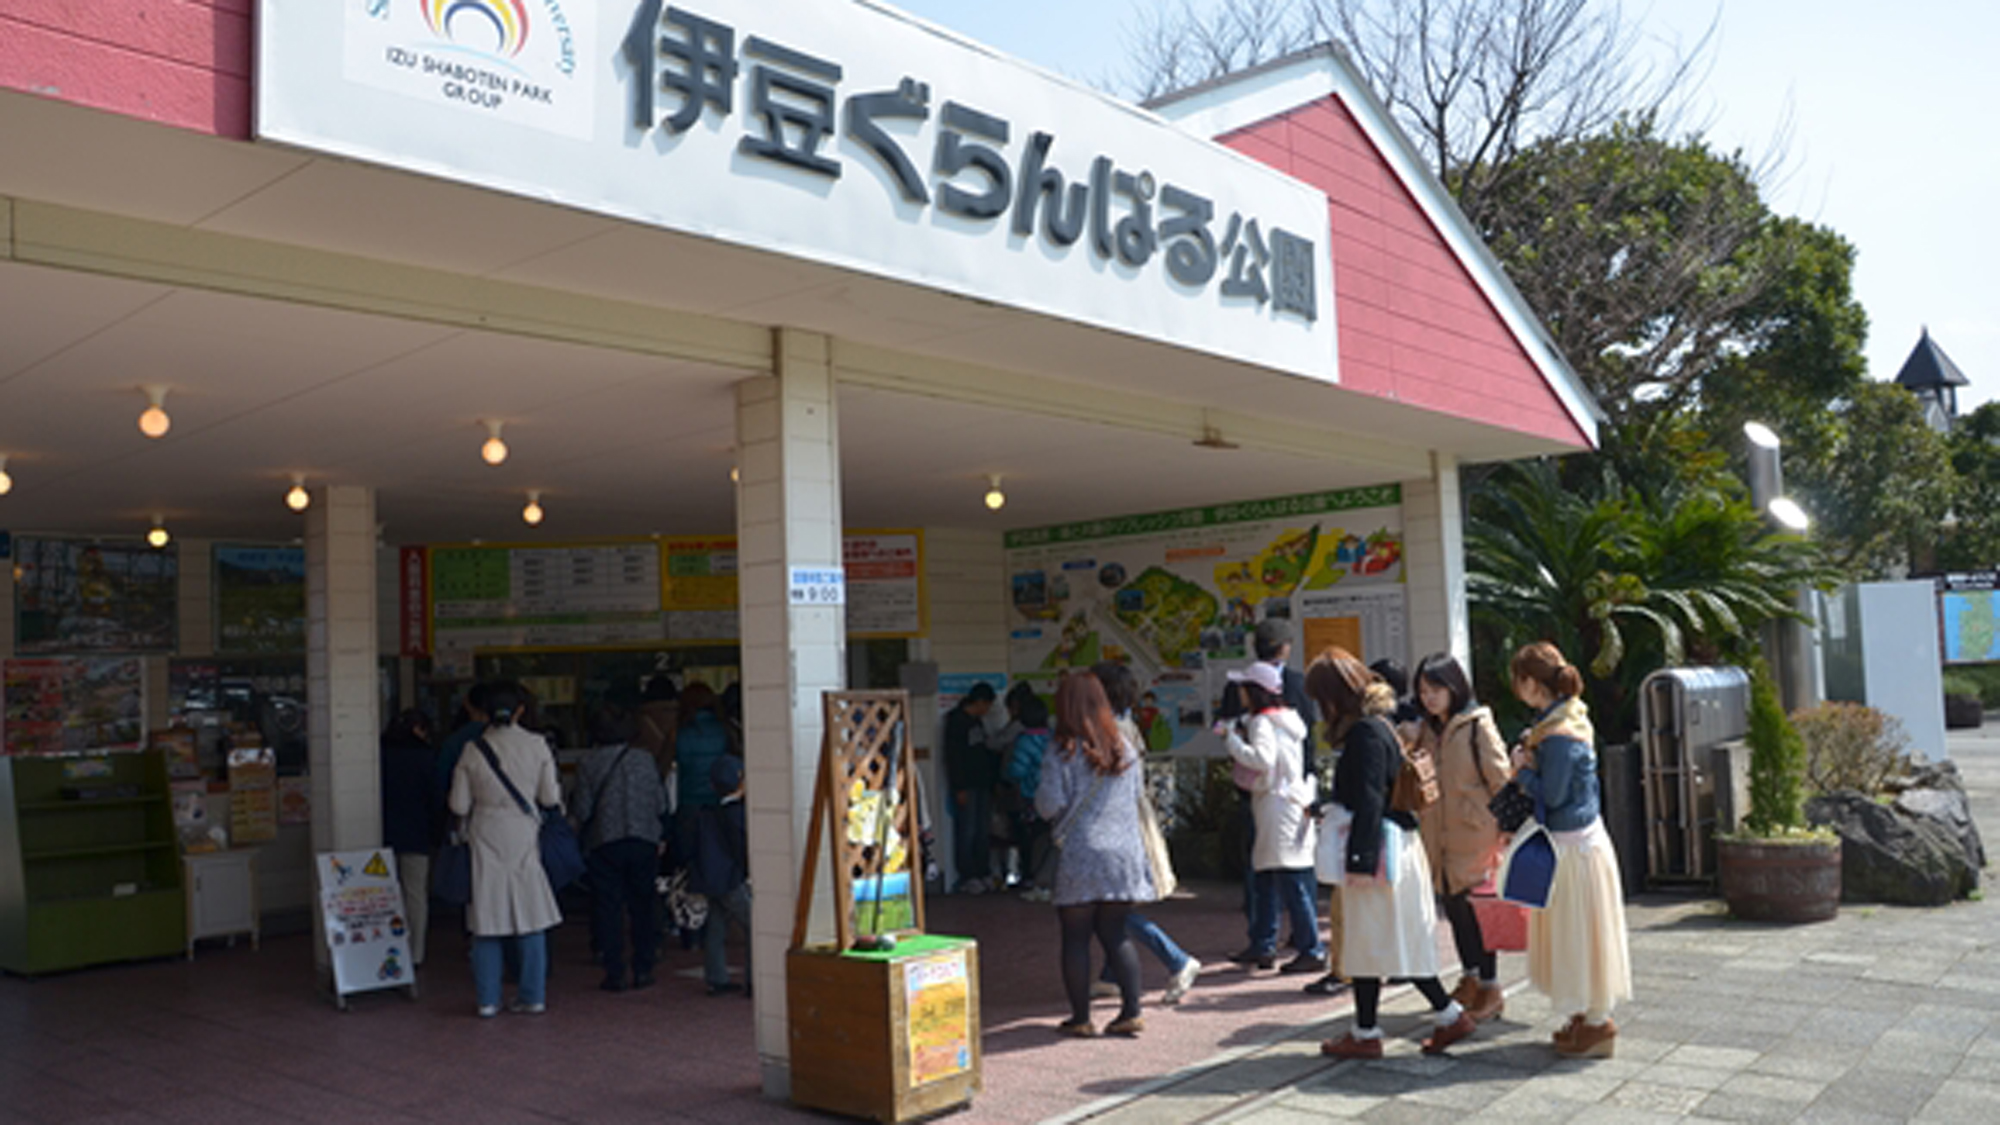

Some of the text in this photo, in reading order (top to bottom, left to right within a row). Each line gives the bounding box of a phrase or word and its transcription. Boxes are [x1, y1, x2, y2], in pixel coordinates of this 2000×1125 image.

[386, 47, 554, 104] IZU SHABOTEN PARK
[443, 82, 503, 109] GROUP
[622, 0, 1317, 322] 伊豆ぐらんぱる公園
[655, 651, 669, 671] 2
